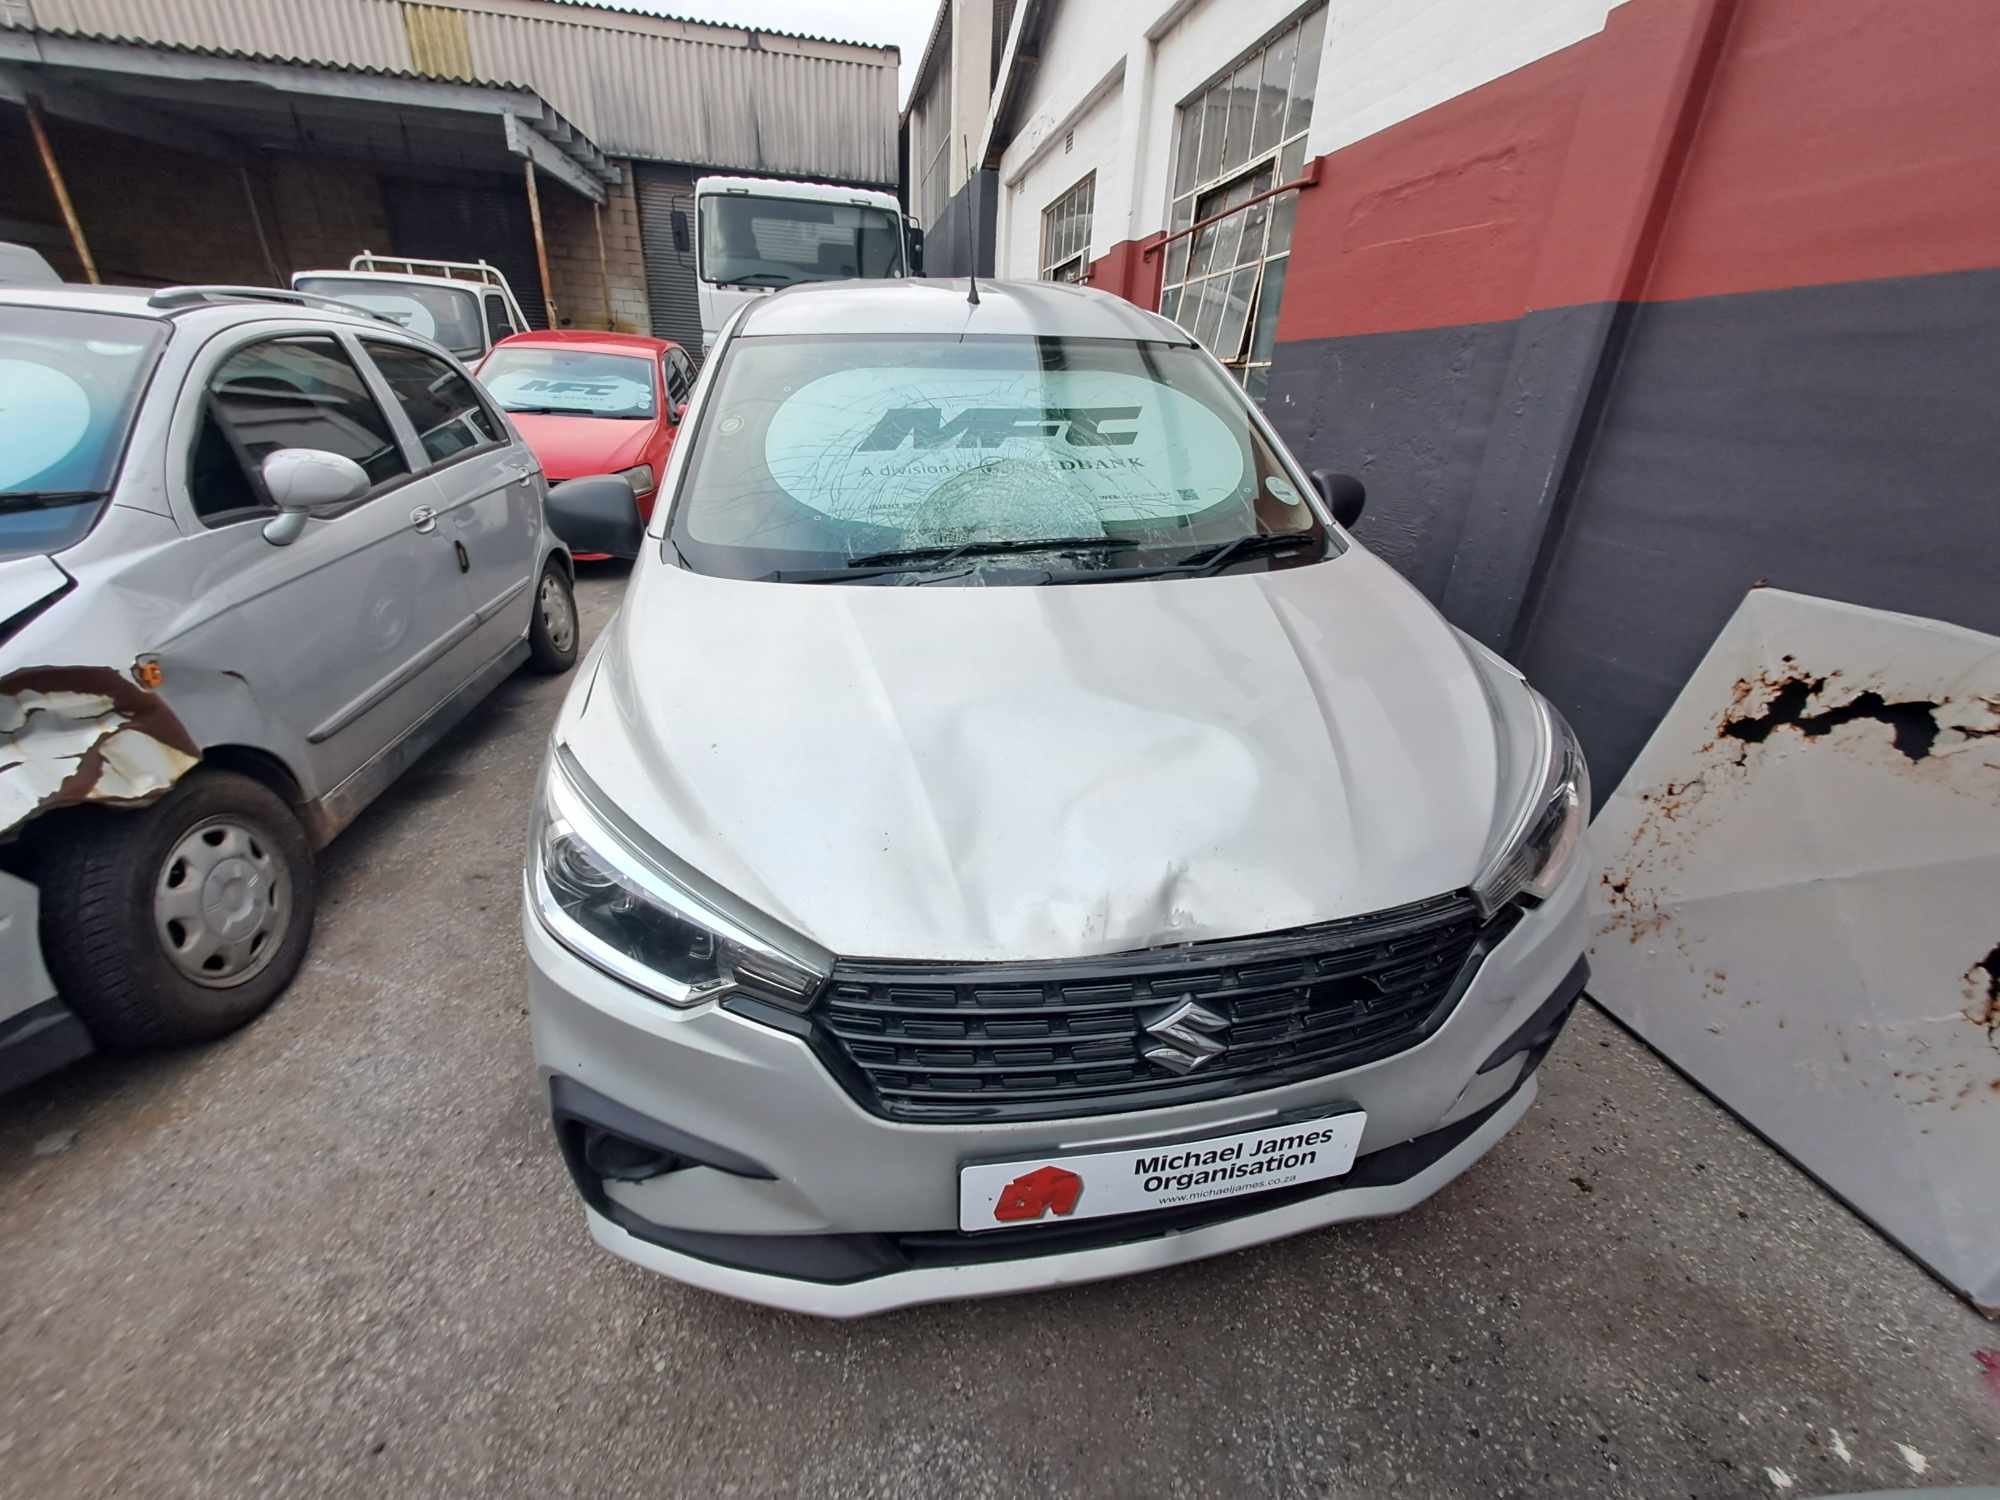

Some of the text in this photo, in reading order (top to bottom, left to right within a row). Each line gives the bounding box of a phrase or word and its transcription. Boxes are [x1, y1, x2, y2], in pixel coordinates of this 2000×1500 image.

[517, 380, 619, 396] MFC
[857, 406, 1144, 452] MFC
[862, 466, 873, 477] A
[880, 463, 951, 476] division
[1134, 1129, 1334, 1175] Michael James
[1143, 1150, 1317, 1193] Organisation
[1158, 1174, 1297, 1205] www.michaeljames.co.za
